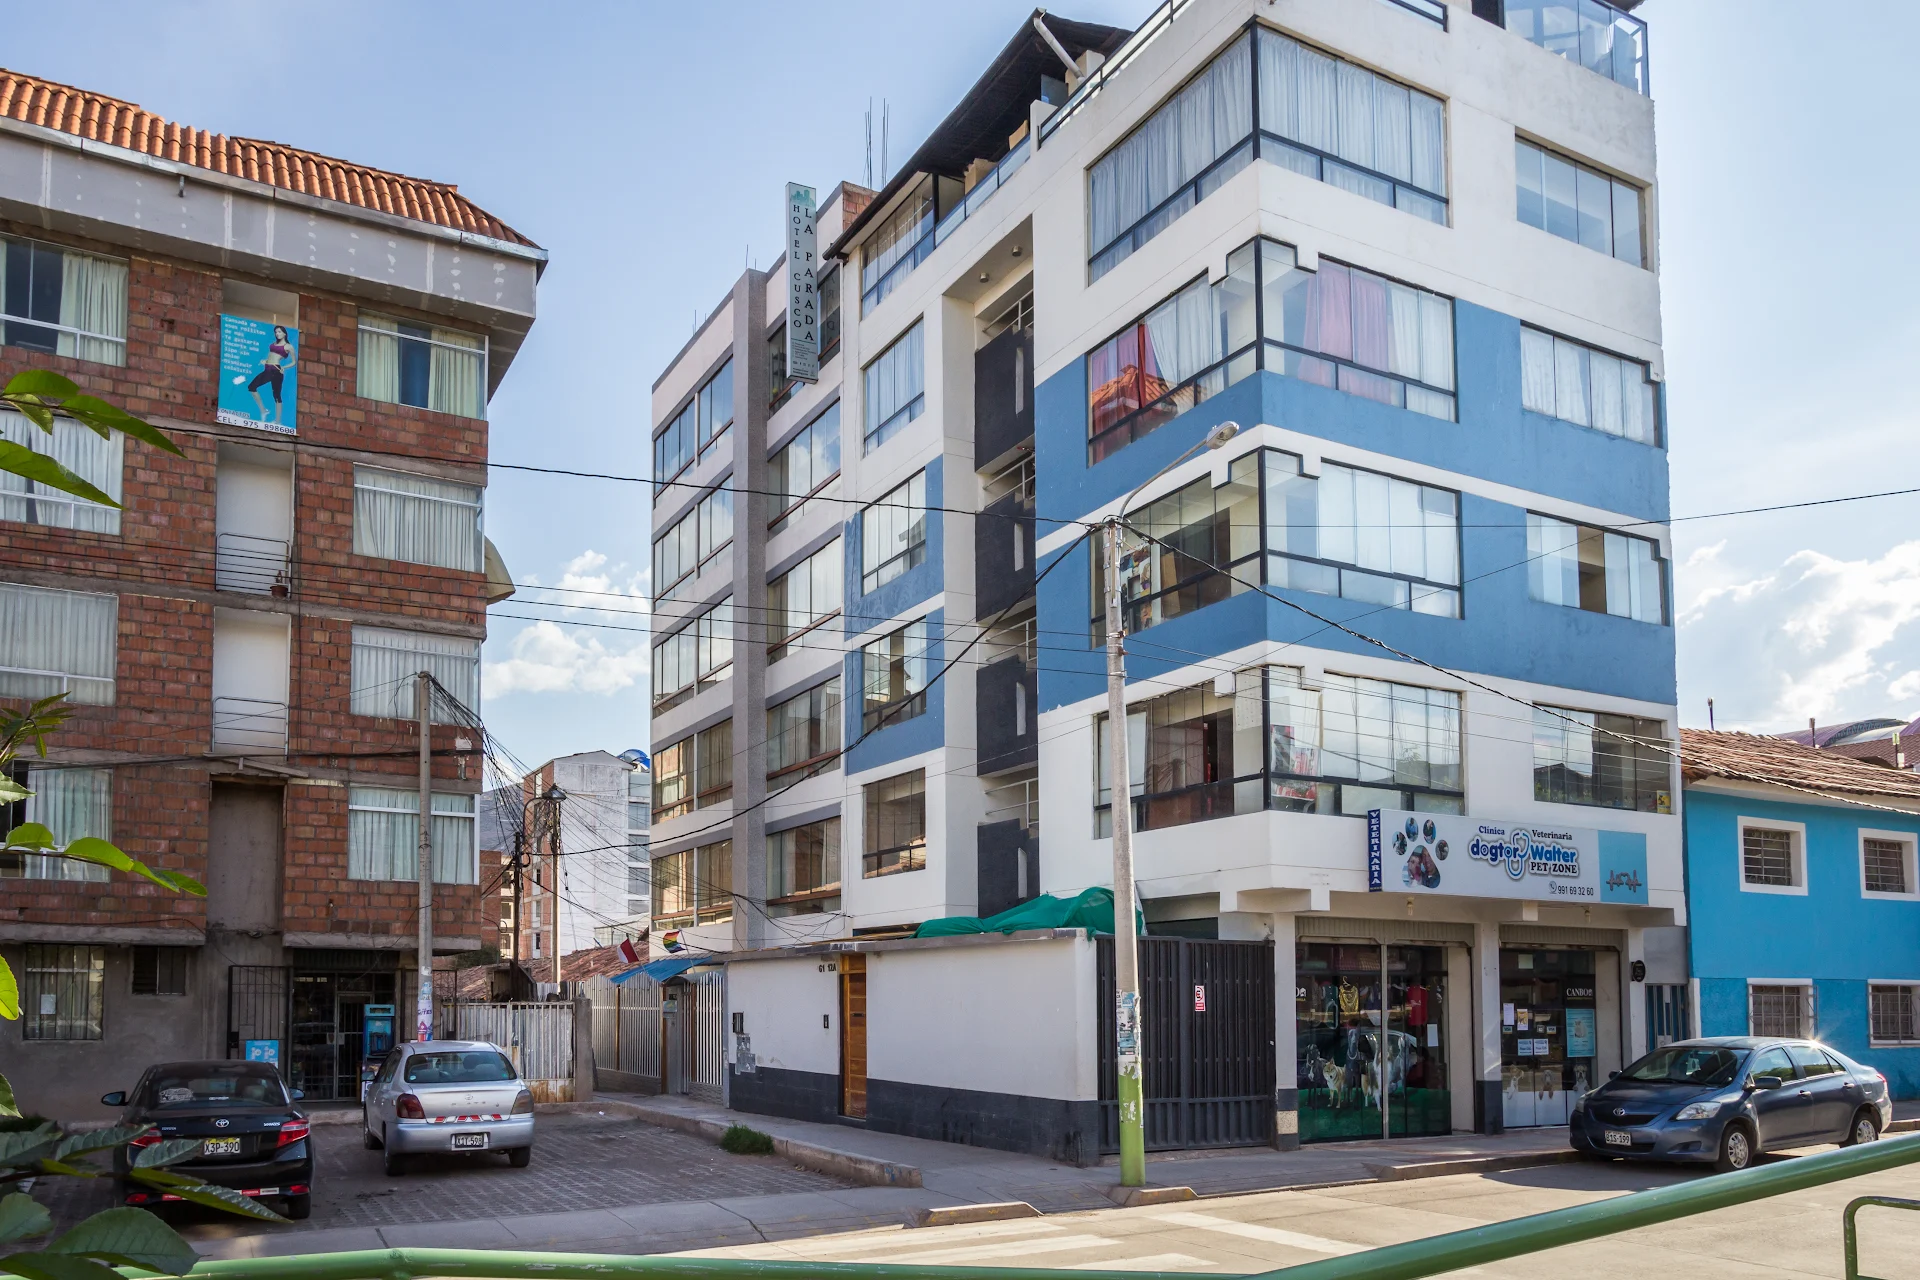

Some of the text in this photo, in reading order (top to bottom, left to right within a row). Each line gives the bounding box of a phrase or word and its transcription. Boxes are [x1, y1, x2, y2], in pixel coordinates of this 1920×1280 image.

[804, 208, 814, 341] LA PARADA
[217, 416, 237, 425] CEL:
[1532, 830, 1572, 840] Veterinaria
[1370, 812, 1381, 884] VETERINARIA
[1470, 839, 1576, 863] dogtor Walter
[1531, 862, 1577, 874] PET ZONE
[1558, 886, 1568, 895] 991
[1578, 887, 1585, 895] 32
[1586, 888, 1594, 896] 60
[1566, 988, 1588, 996] CANBO
[205, 1142, 240, 1152] X3P-390
